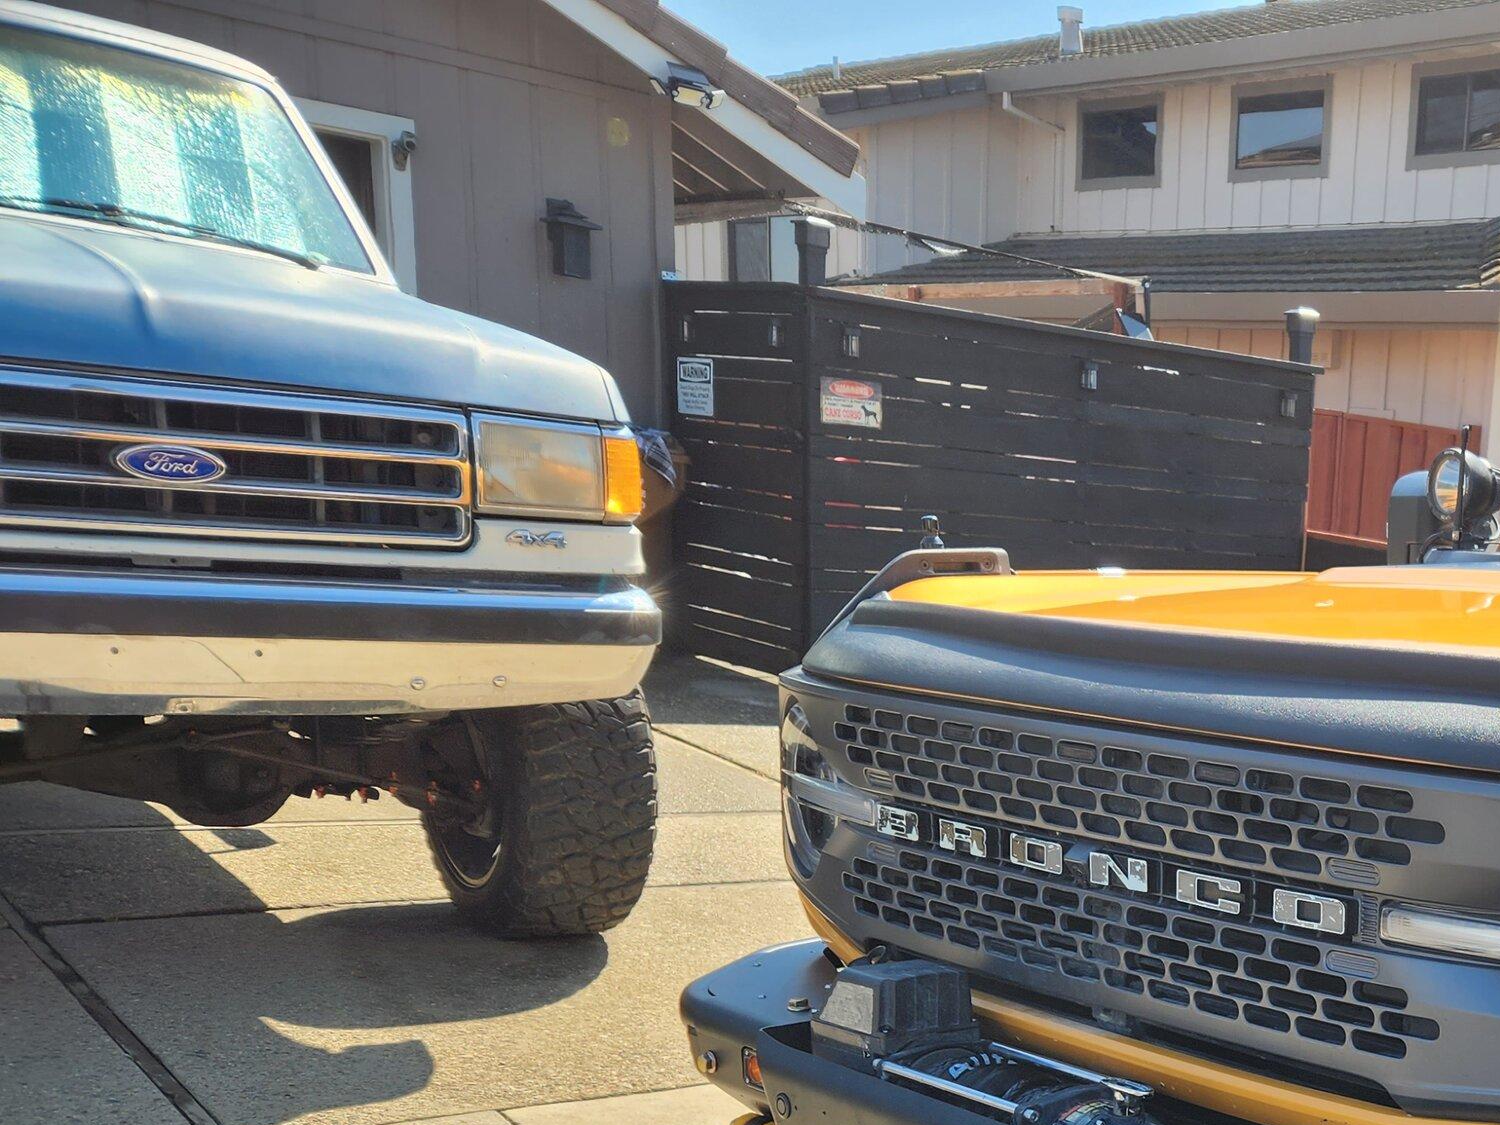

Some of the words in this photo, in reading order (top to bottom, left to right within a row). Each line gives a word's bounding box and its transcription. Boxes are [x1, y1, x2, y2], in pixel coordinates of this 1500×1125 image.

[682, 365, 708, 379] WARNING
[143, 451, 198, 474] Ford
[505, 528, 567, 549] 4x4
[875, 803, 1347, 936] BRONCO
